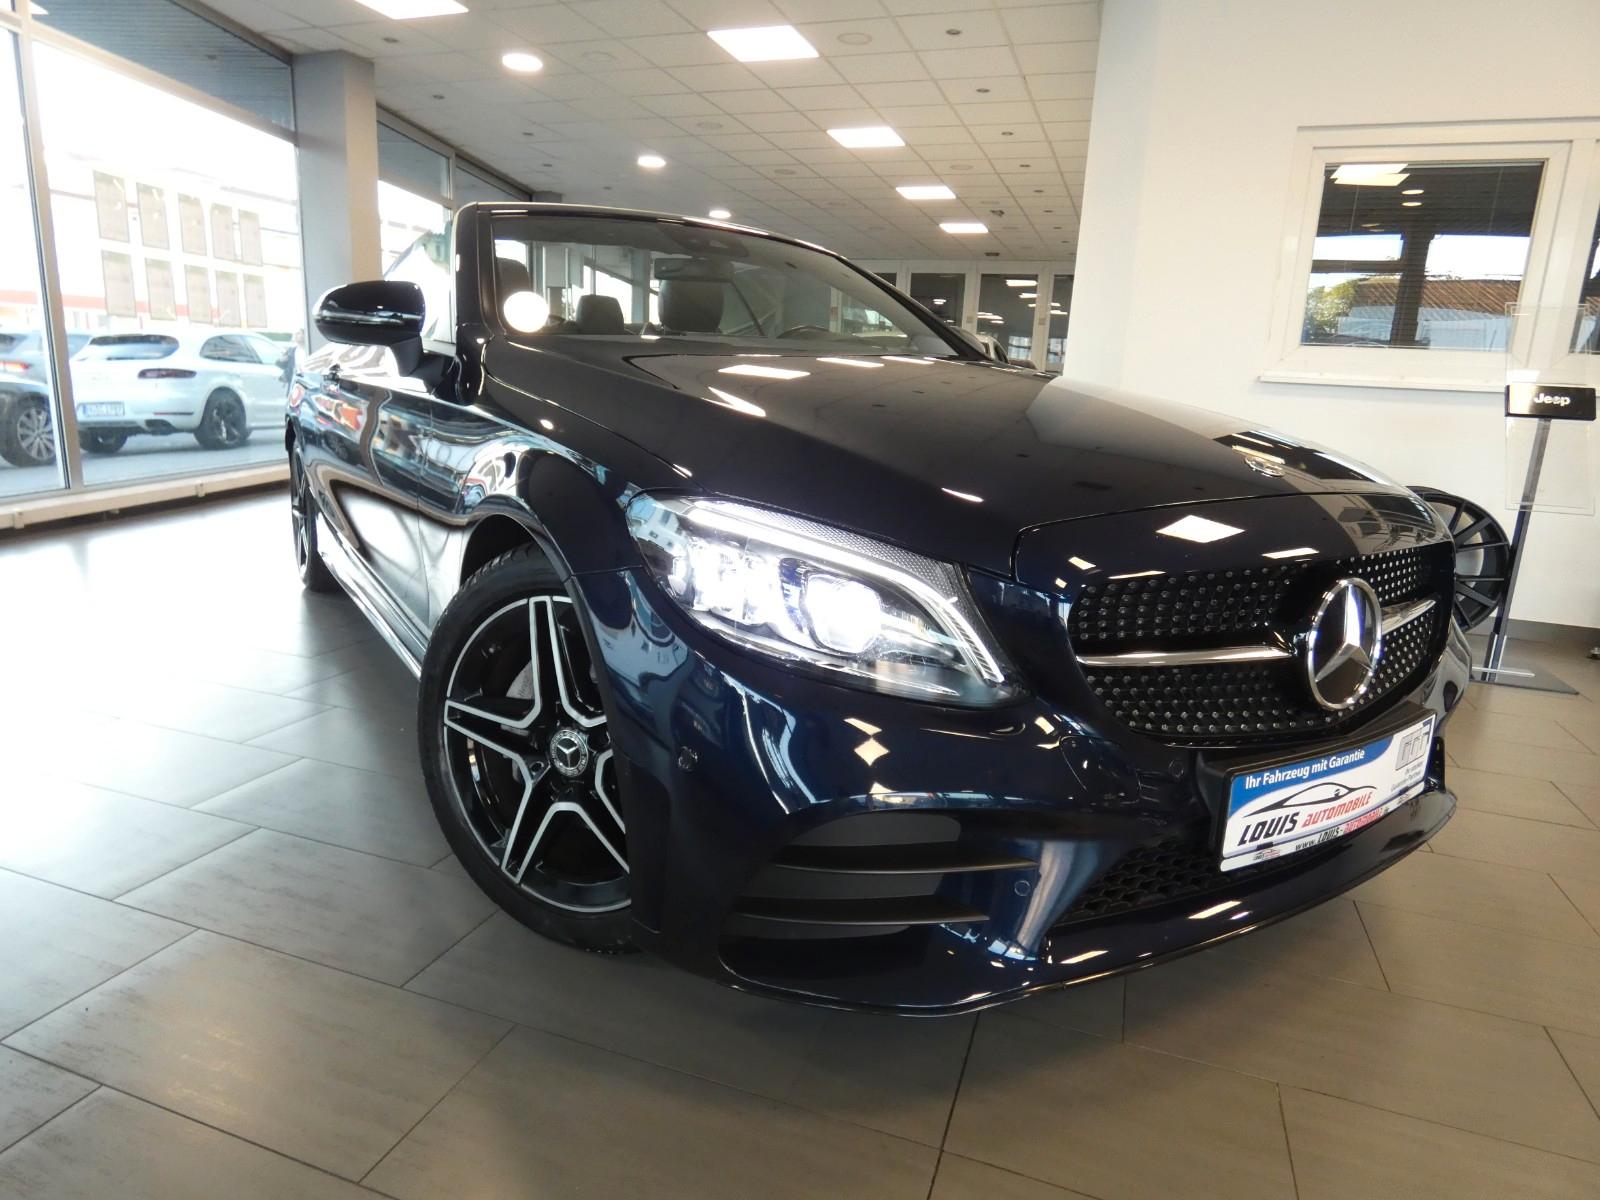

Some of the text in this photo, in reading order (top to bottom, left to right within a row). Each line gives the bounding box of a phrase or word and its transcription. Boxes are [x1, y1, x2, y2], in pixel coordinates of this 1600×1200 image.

[1533, 393, 1571, 407] Jeep
[1245, 749, 1365, 790] Ihr Fahrzeug mit Garantie
[1237, 811, 1300, 847] LOUIS
